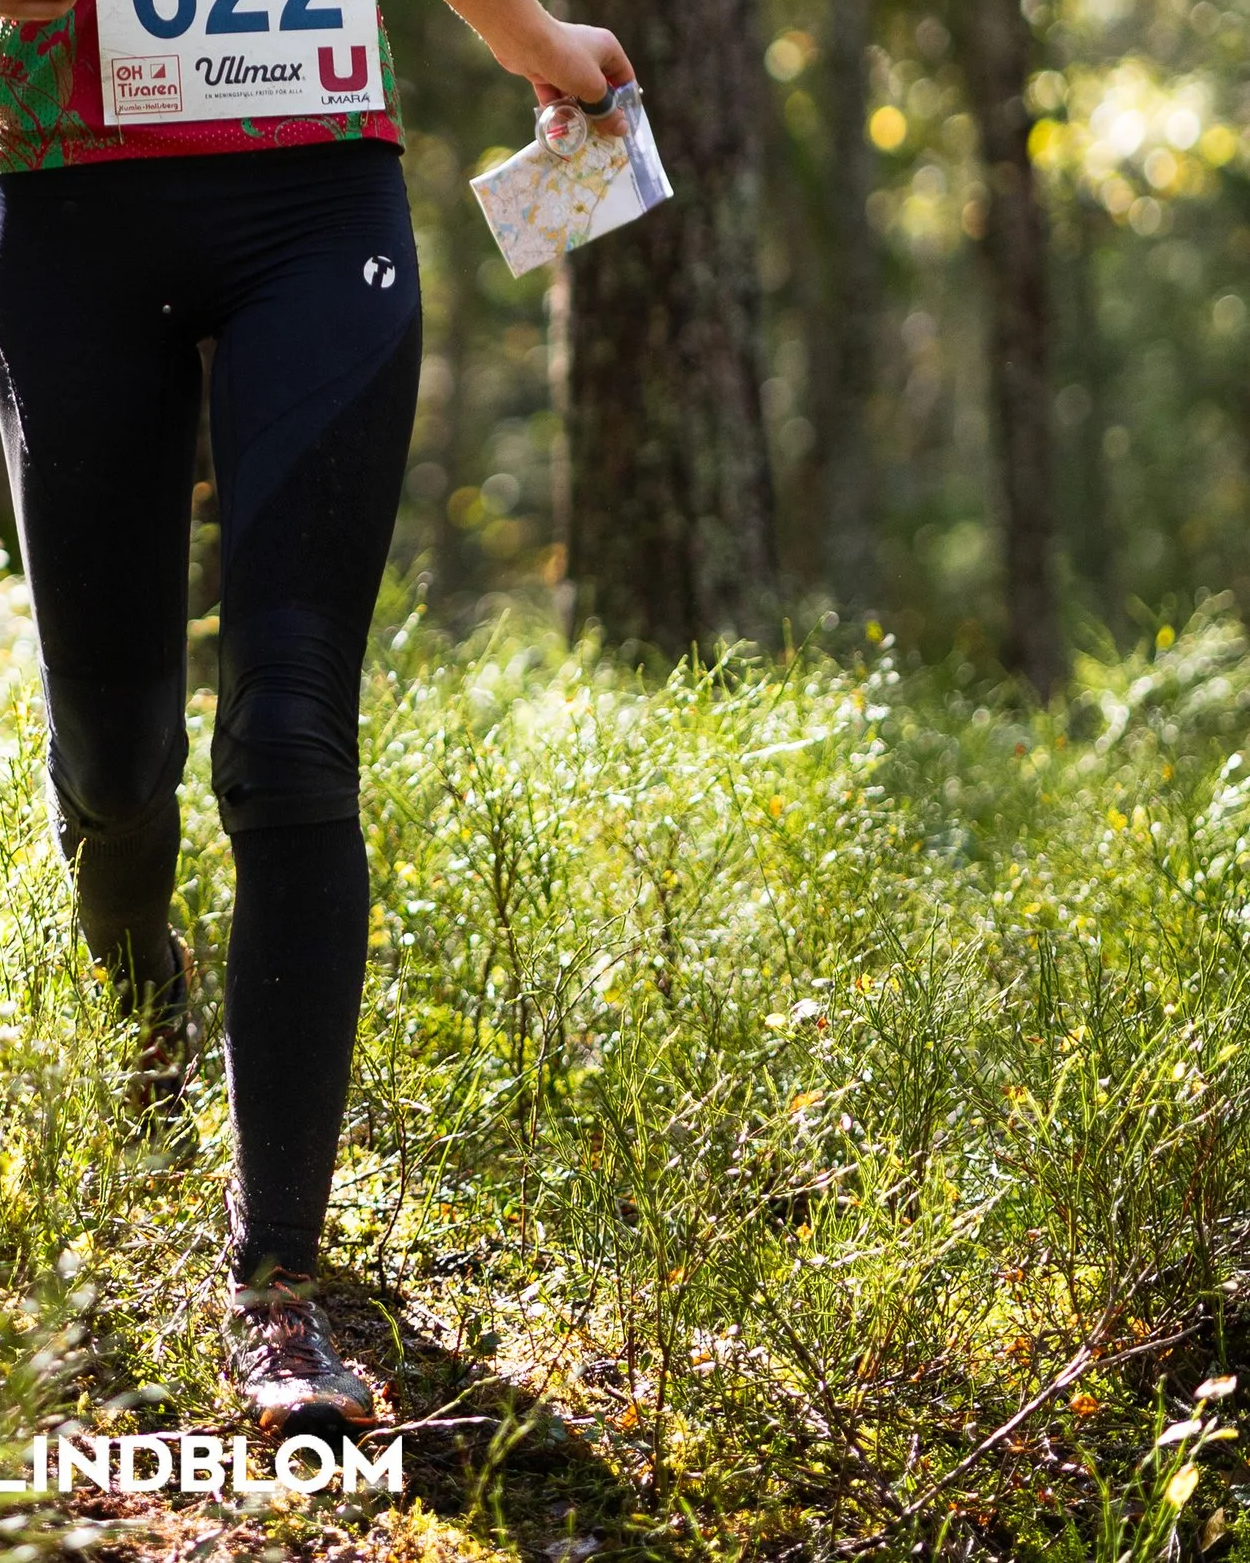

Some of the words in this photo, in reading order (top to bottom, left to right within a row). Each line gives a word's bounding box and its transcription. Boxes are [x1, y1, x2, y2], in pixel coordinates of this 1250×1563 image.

[195, 55, 303, 86] Ullmax
[117, 83, 178, 98] Tisaren
[321, 93, 370, 105] UMARA
